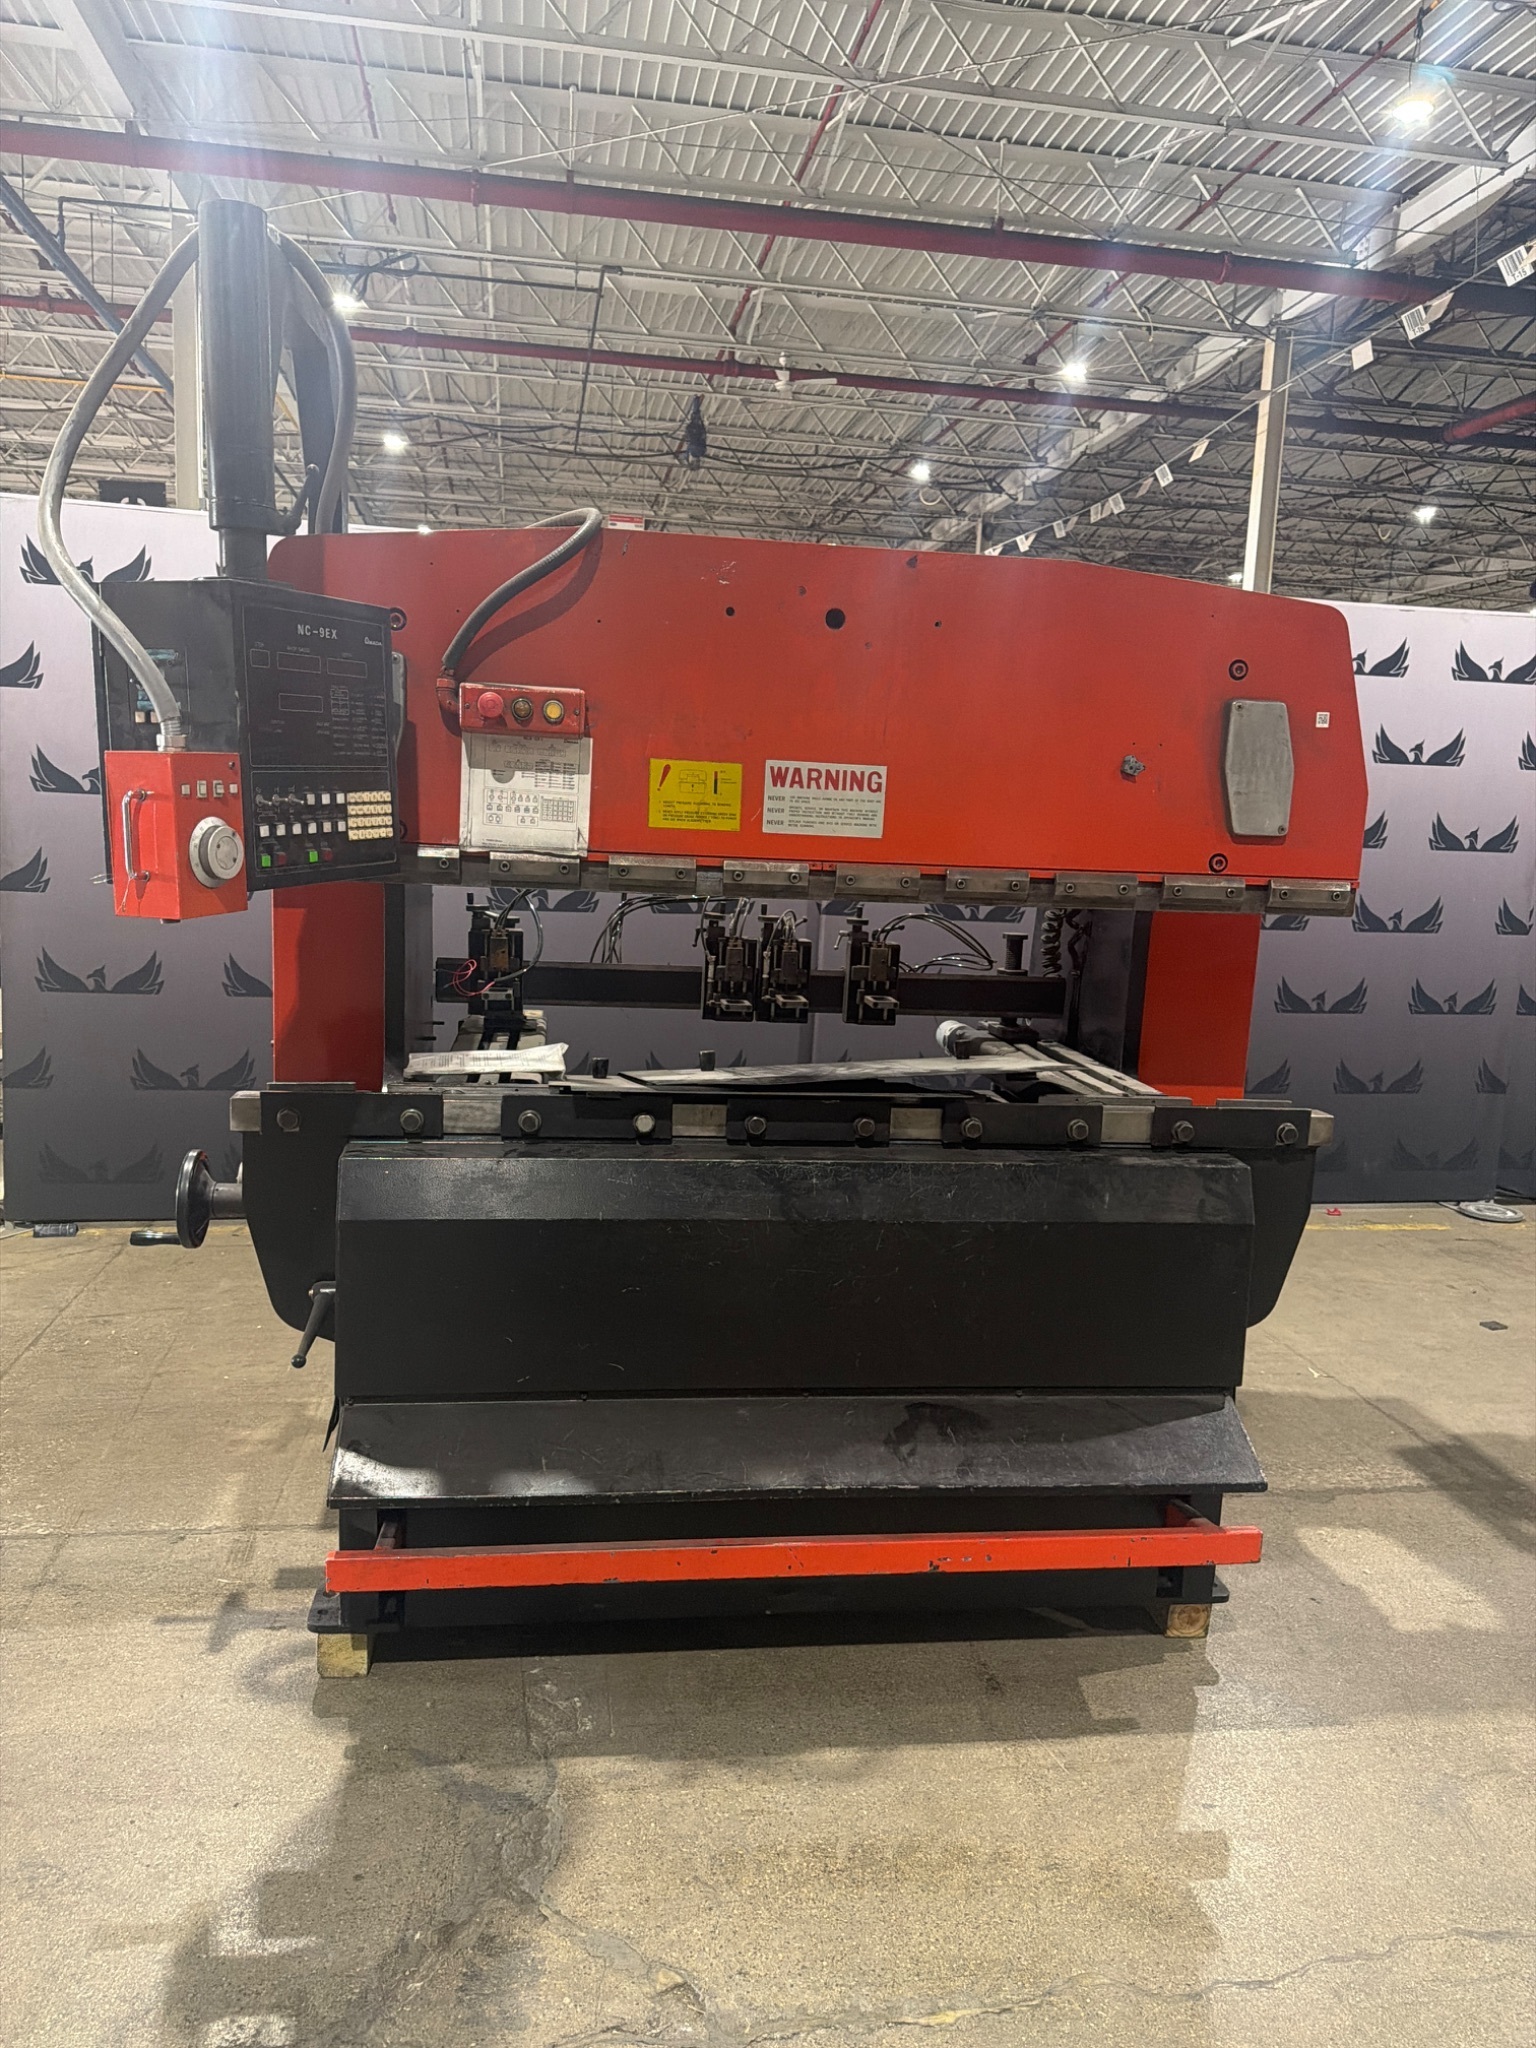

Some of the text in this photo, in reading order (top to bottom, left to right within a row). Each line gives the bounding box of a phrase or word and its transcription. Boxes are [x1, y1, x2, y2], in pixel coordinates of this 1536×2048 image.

[1511, 267, 1528, 281] T-15
[297, 624, 338, 640] NC-9EX
[769, 765, 883, 793] WARNING
